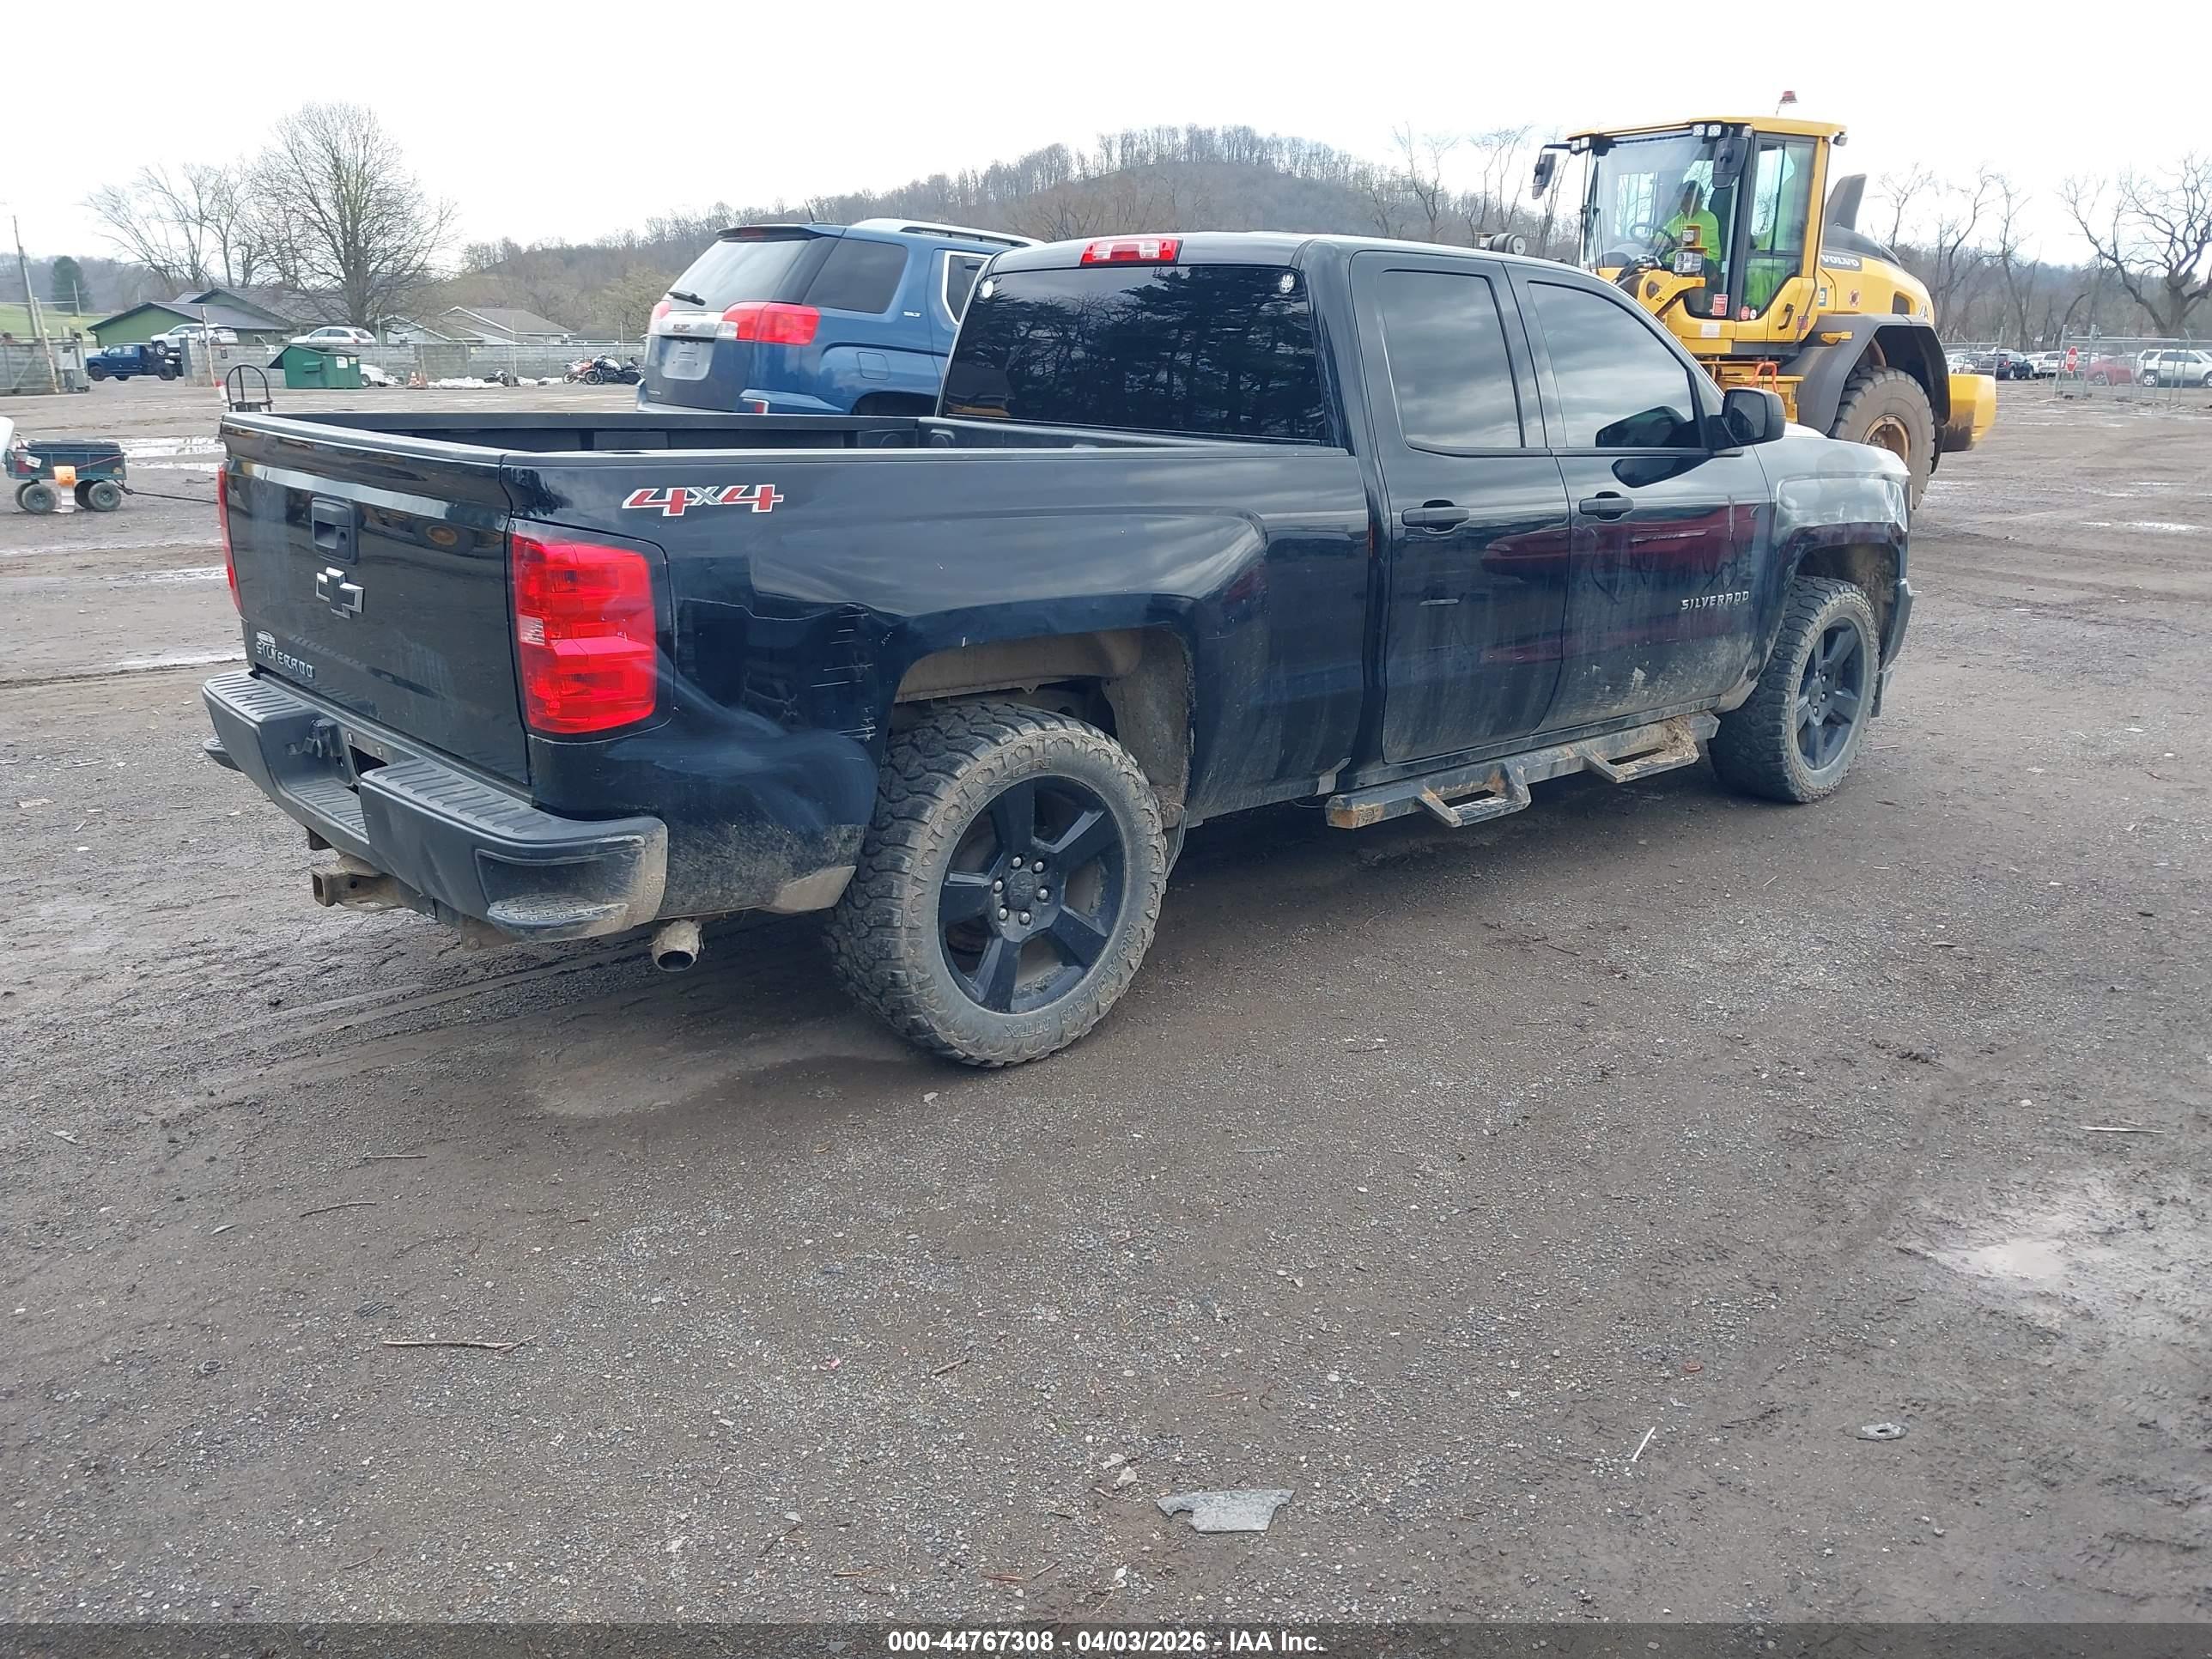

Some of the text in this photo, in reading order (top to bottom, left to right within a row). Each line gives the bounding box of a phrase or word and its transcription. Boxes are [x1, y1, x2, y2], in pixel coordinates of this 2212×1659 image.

[1820, 254, 1860, 267] VOLVO
[1680, 591, 1750, 610] SILVERADO
[256, 641, 314, 678] SILVERADO
[1003, 1017, 1052, 1038] MTX
